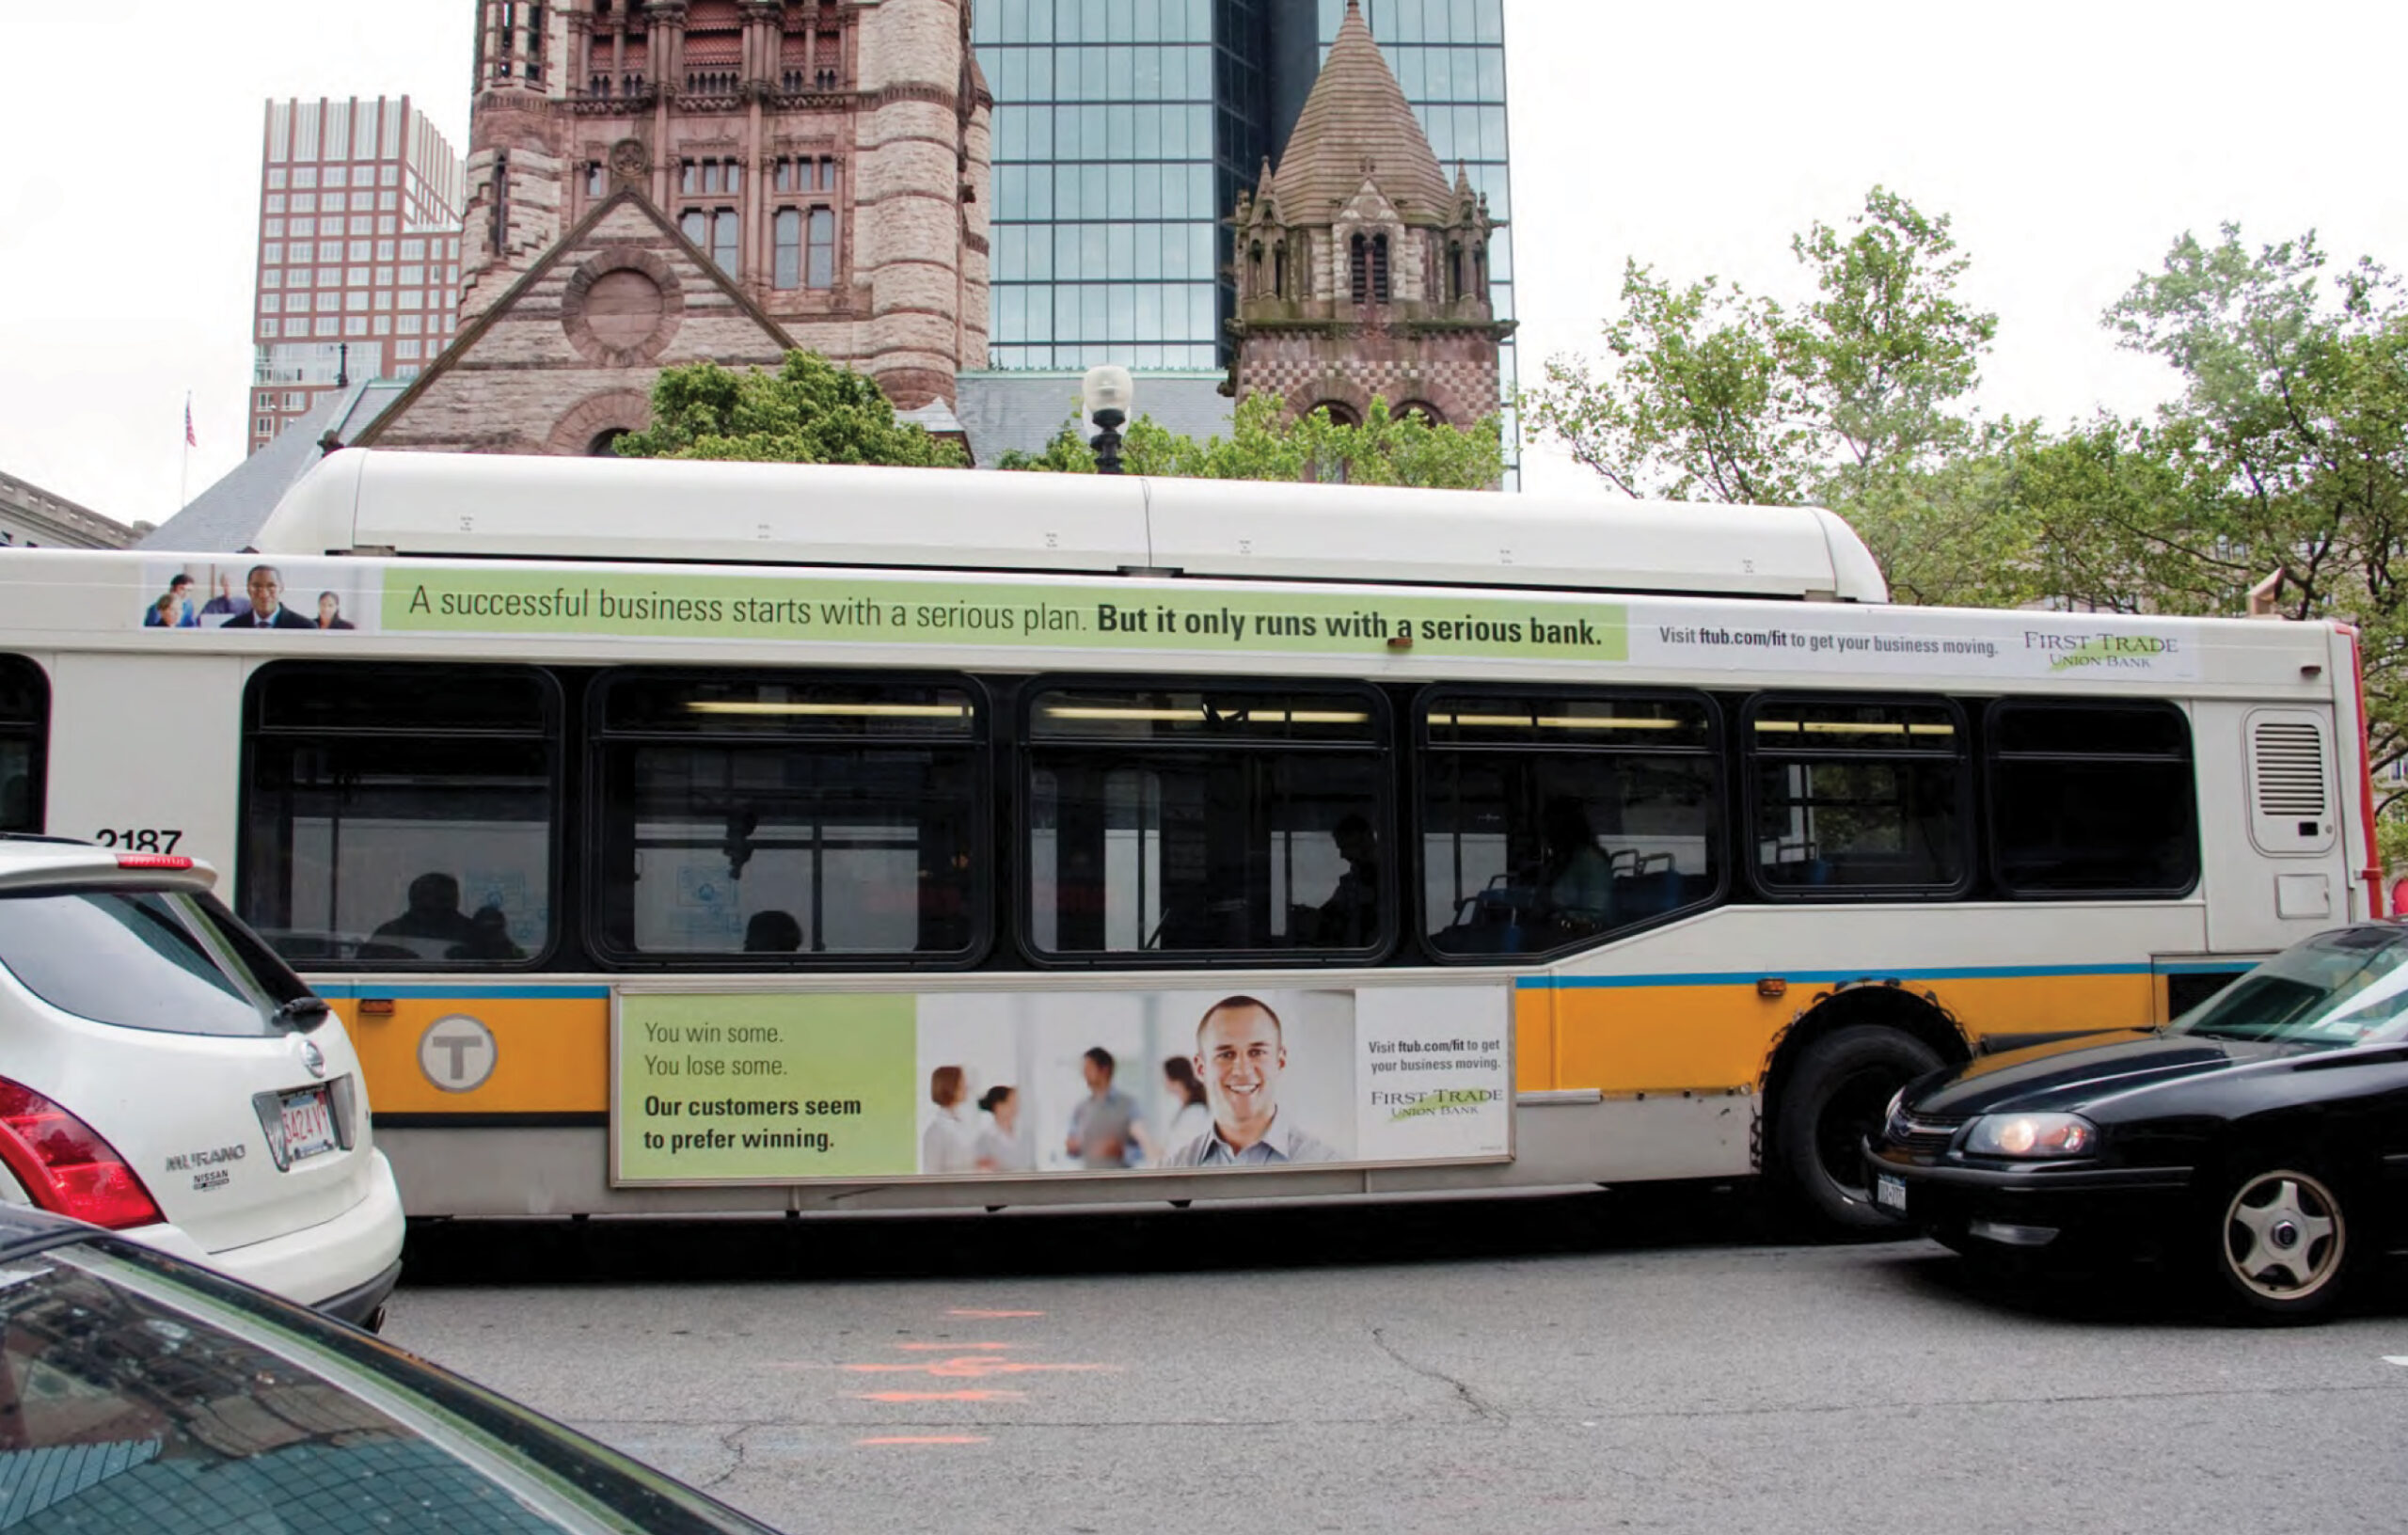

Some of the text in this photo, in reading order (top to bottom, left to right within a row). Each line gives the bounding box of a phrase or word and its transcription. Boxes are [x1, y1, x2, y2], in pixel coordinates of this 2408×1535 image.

[409, 585, 1602, 645] A successful business starts with a serious plan. But it only runs with a serious bank.
[1660, 626, 1999, 657] Visit ftub.com/fit to get your business moving.
[2024, 631, 2178, 653] FIRST TRADE
[2050, 654, 2150, 668] UNION BANK
[644, 1022, 784, 1043] You win some.
[1369, 1038, 1500, 1053] Visit ftub.com/fit to get
[432, 1036, 483, 1080] T
[644, 1054, 787, 1076] You lose some.
[1370, 1056, 1500, 1075] your business moving.
[644, 1096, 862, 1116] Our customers seem
[1370, 1088, 1503, 1106] FIRST TRADE
[1390, 1105, 1479, 1117] UNION BANK
[643, 1129, 834, 1154] to prefer winning.
[166, 1144, 246, 1172] MURANO
[193, 1169, 229, 1183] NISSAN
